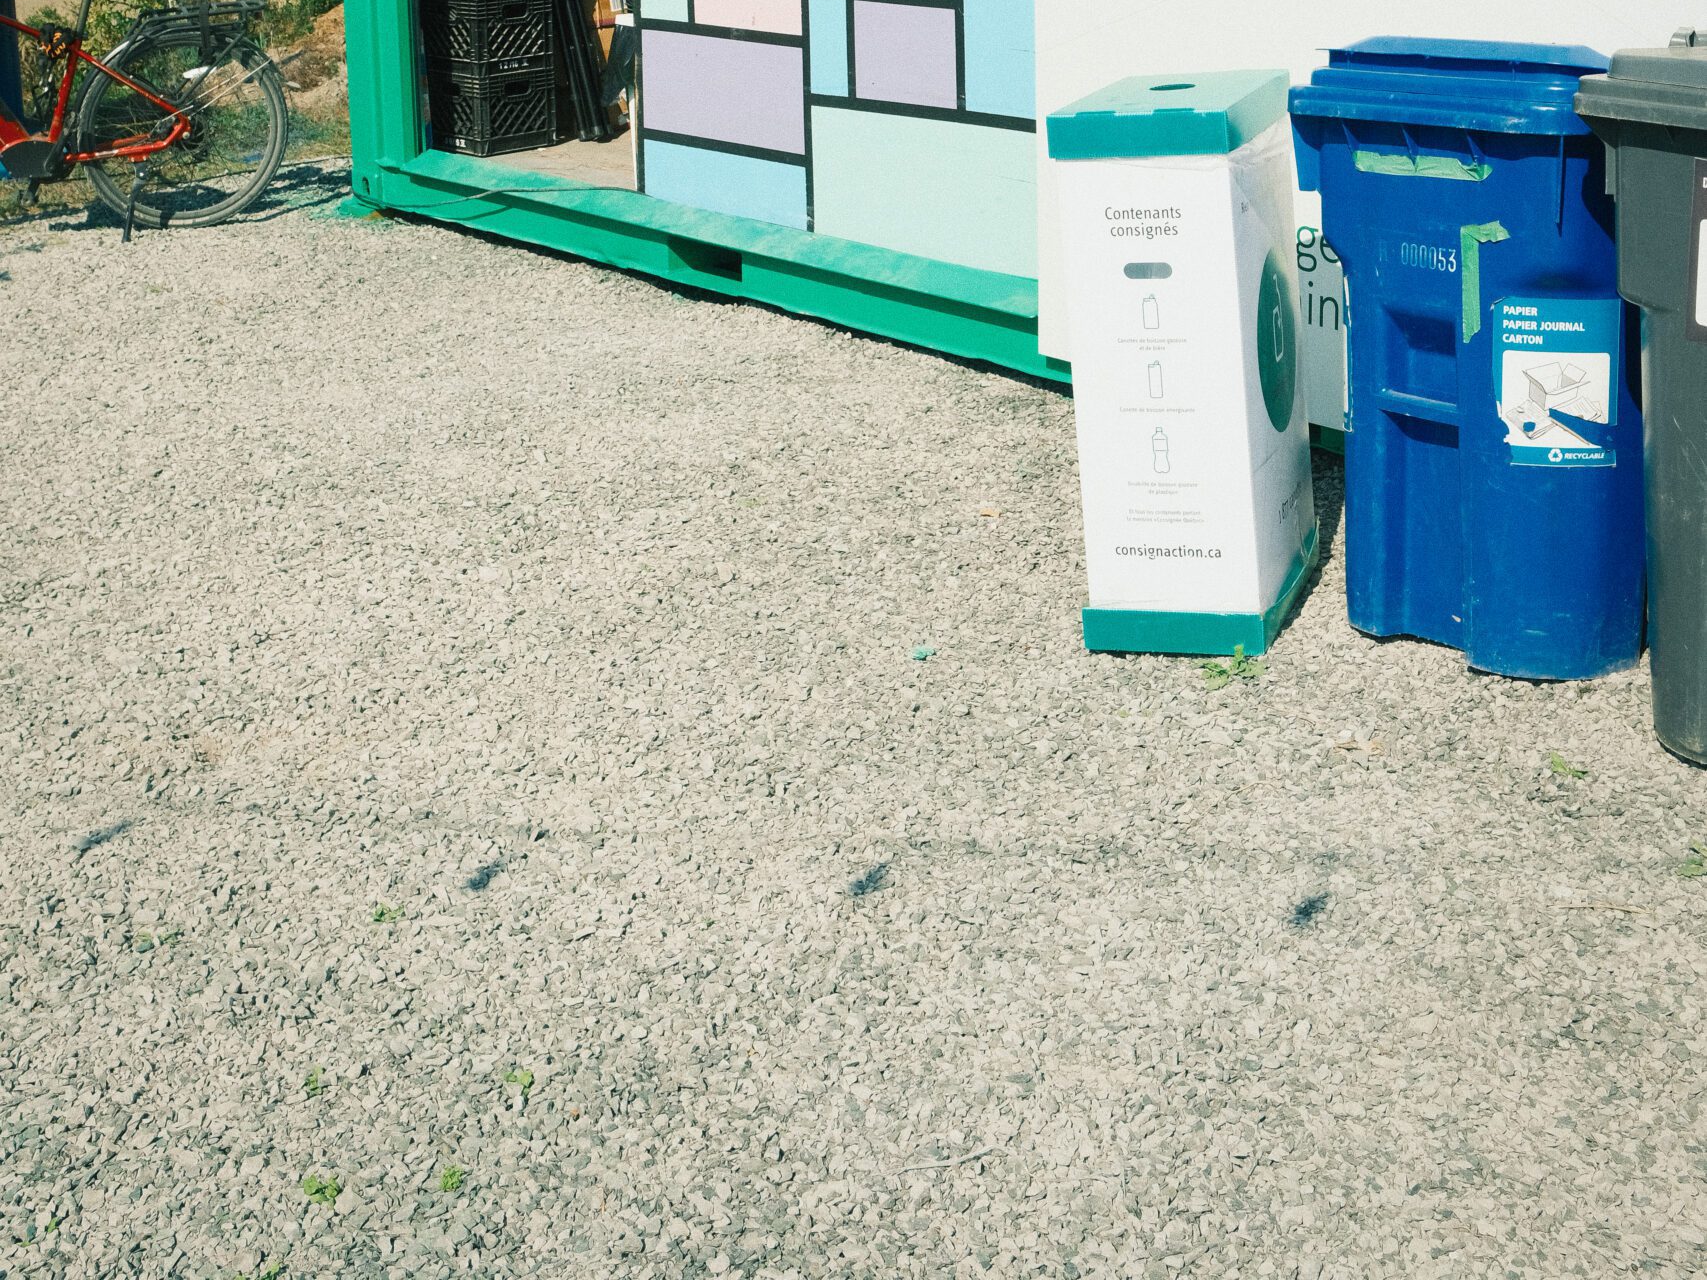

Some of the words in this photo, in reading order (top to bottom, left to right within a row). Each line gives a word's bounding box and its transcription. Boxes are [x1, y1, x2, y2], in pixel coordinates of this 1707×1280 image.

[1105, 206, 1181, 220] Contenants
[1110, 222, 1179, 239] consignés
[1401, 242, 1456, 272] 000053
[1299, 280, 1339, 330] in
[1503, 305, 1538, 317] PAPIER
[1502, 319, 1537, 331] PAPIER
[1539, 321, 1585, 332] JOURNAL
[1502, 333, 1543, 345] CARTON
[1564, 452, 1605, 460] RECYCLABLE
[1115, 543, 1222, 560] consignaction.ca
